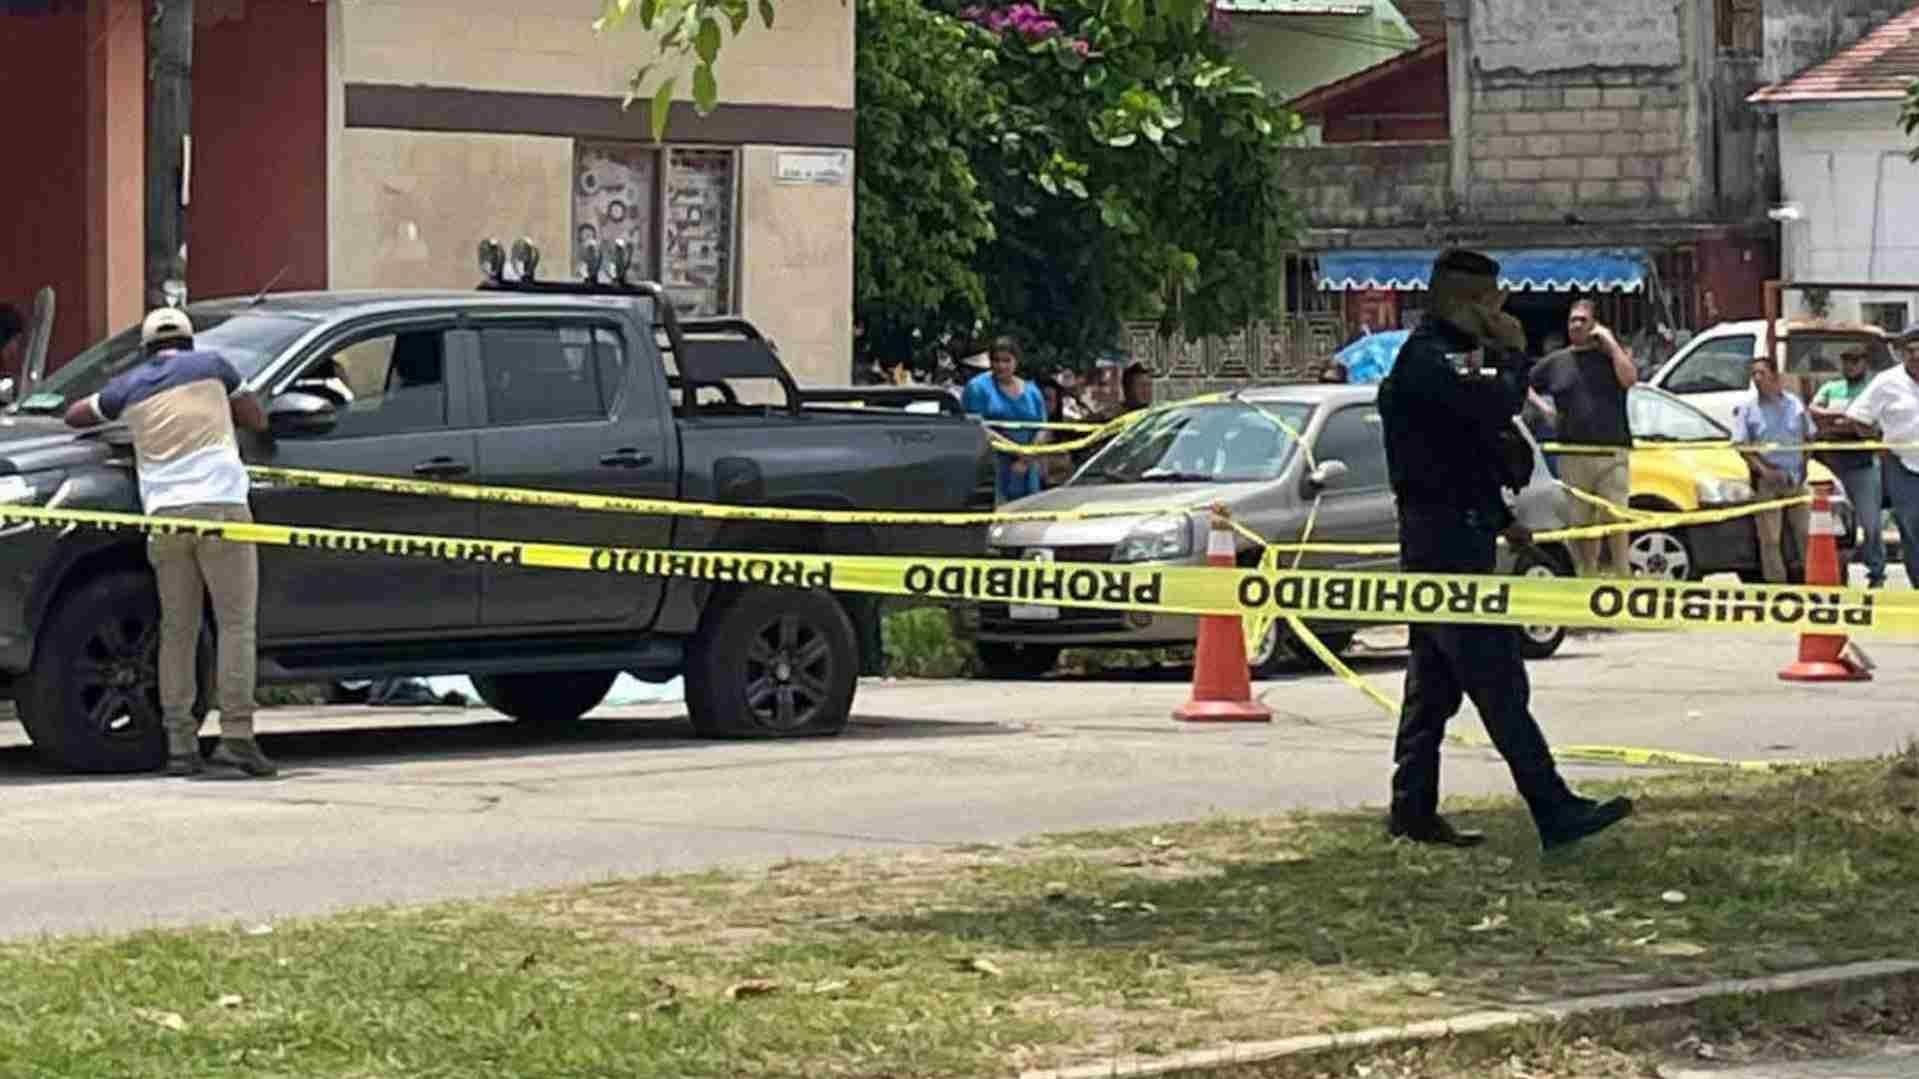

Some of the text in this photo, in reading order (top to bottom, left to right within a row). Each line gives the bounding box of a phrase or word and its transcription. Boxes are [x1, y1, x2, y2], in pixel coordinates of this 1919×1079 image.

[904, 563, 1162, 604] PROHIBIDO
[1238, 574, 1511, 614] PROHIBIDO
[1589, 584, 1874, 626] PROHIBIDO
